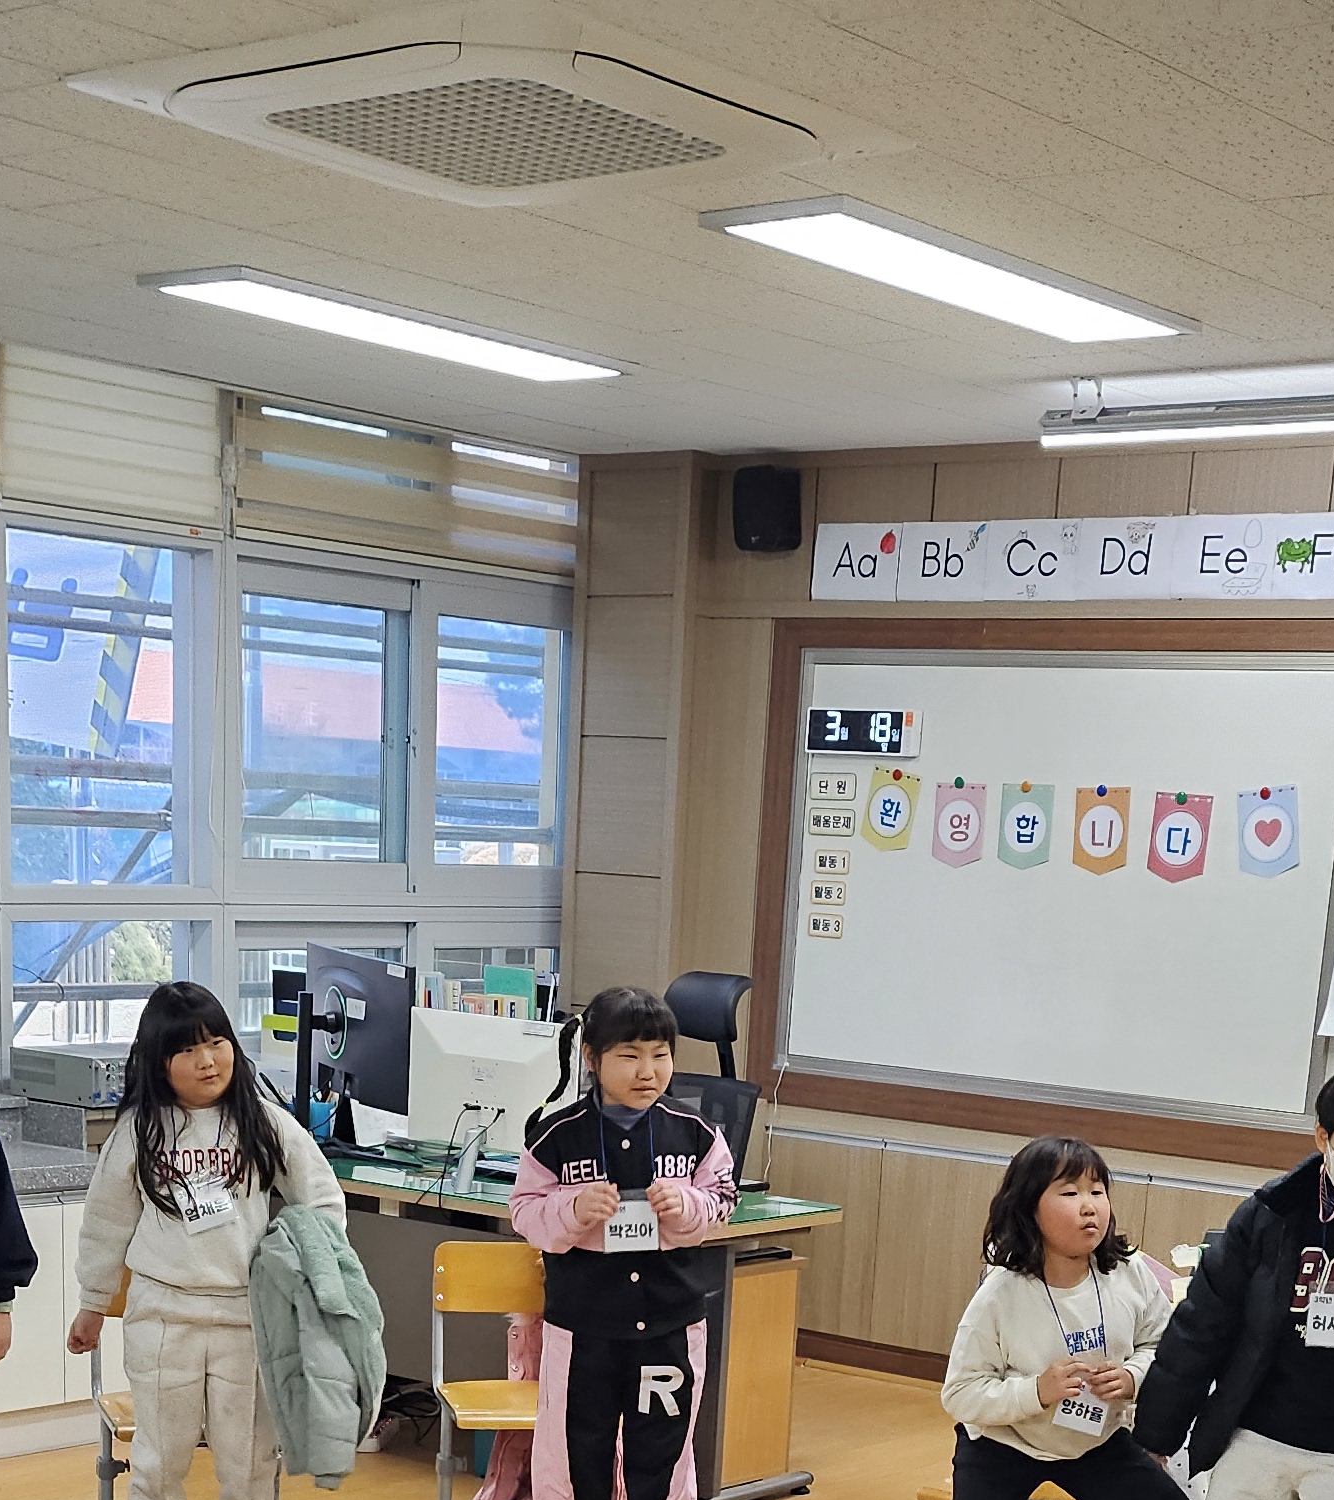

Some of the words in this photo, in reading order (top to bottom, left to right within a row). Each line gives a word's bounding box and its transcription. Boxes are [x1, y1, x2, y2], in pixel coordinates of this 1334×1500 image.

[833, 542, 877, 578] Aa
[921, 538, 964, 578] Bb
[1006, 538, 1057, 577] Cc
[1100, 534, 1153, 576] Dd
[1199, 535, 1248, 574] Ee
[812, 814, 852, 830] 배움문제
[841, 856, 847, 869] 1
[836, 887, 843, 900] 2
[833, 920, 841, 933] 3
[608, 1221, 655, 1239] 박진아
[638, 1365, 685, 1417] R
[1060, 1398, 1104, 1424] 양하율
